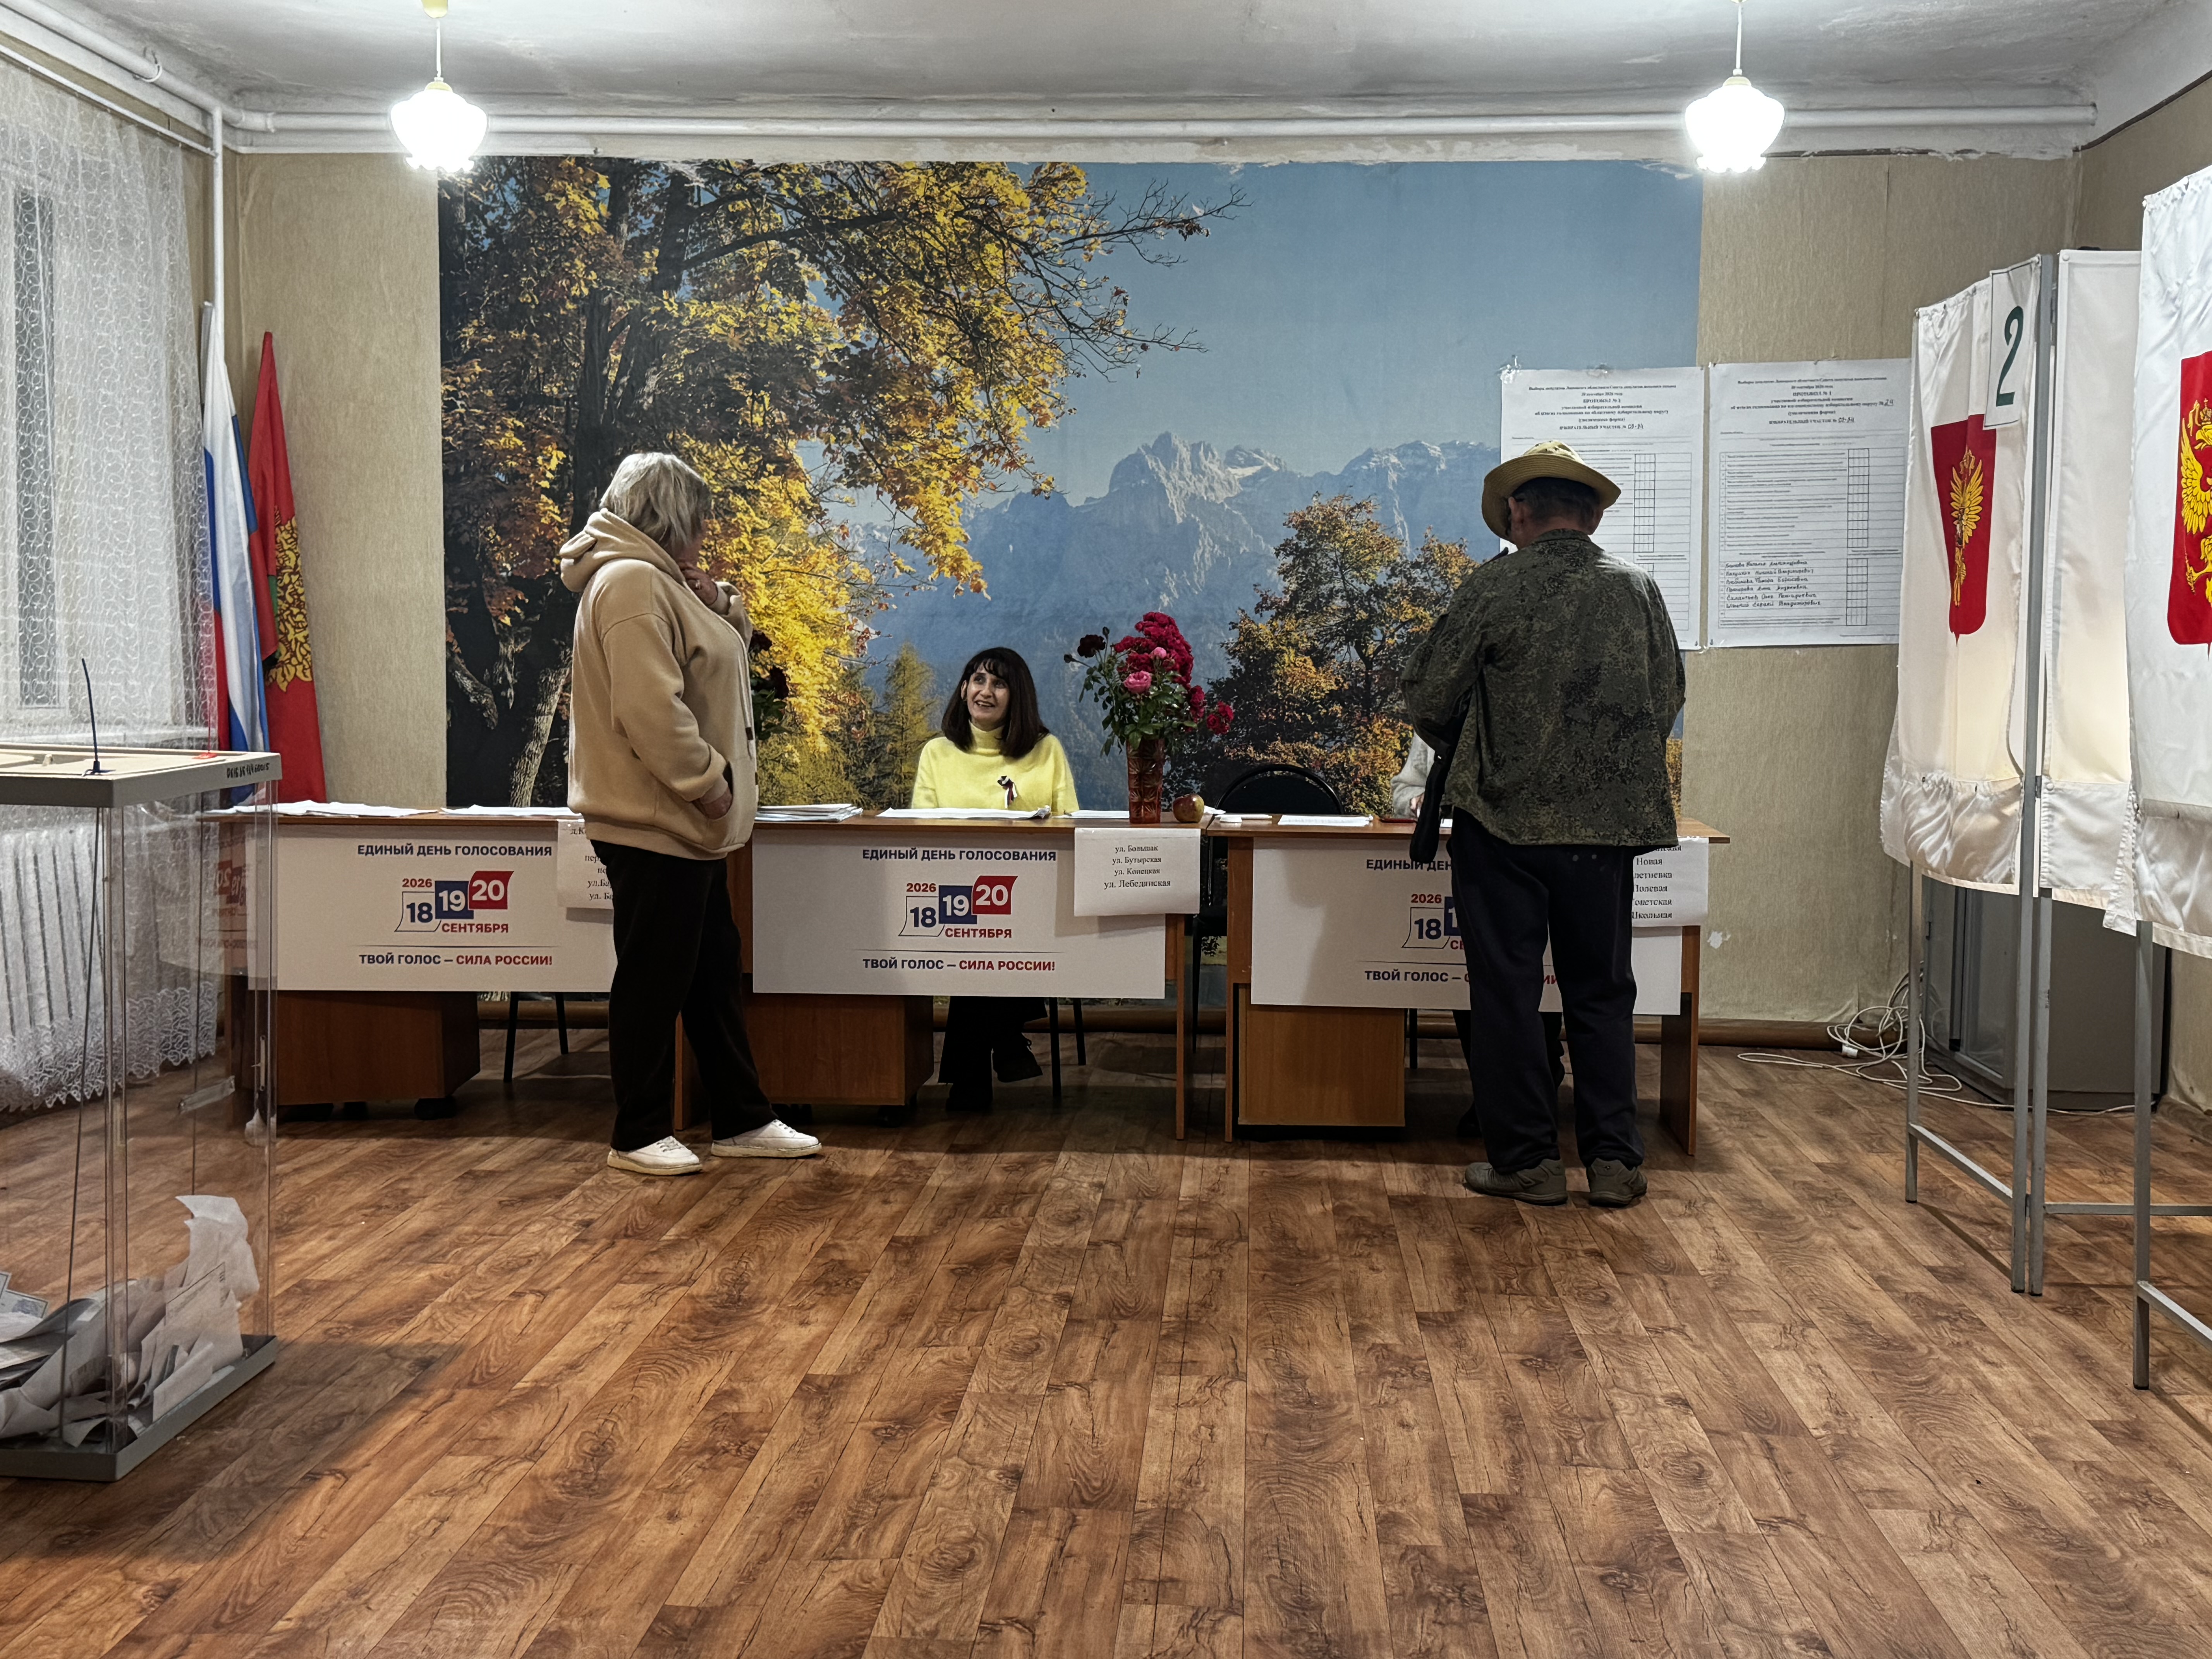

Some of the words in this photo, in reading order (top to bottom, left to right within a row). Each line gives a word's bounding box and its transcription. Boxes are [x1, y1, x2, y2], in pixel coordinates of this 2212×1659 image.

[1996, 305, 2024, 407] 2
[357, 843, 414, 856] ЕДИНЫЙ
[417, 845, 452, 857] ДЕНЬ
[455, 845, 552, 856] ГОЛОСОВАНИЯ
[862, 847, 918, 860] ЕДИНЫЙ
[921, 850, 956, 861] ДЕНЬ
[959, 850, 1056, 861] ГОЛОСОВАНИЯ
[1125, 856, 1161, 865] Бутырская
[1427, 860, 1452, 872] ДЕН
[1637, 857, 1662, 866] Новая
[402, 878, 433, 888] 2026
[906, 883, 936, 892] 2026
[1104, 881, 1116, 890] ул.
[1118, 879, 1171, 888] Лебедянская
[472, 879, 505, 901] 20
[975, 884, 1008, 906] 20
[438, 890, 466, 912] 19
[589, 893, 601, 901] ул.
[1411, 893, 1442, 904] 2026
[943, 895, 969, 916] 19
[406, 902, 433, 923] 18
[910, 907, 937, 928] 18
[1448, 907, 1458, 928] 1
[441, 923, 509, 933] СЕНТЯБРЯ
[945, 928, 1012, 938] СЕНТЯБРЯ
[1414, 918, 1442, 940] 18
[359, 952, 394, 965] ТВОЙ
[398, 954, 441, 965] ГОЛОС
[456, 955, 492, 965] СИЛА
[495, 955, 553, 965] РОССИИ!
[862, 957, 897, 969] ТВОЙ
[901, 959, 944, 970] ГОЛОС
[959, 960, 994, 970] СИЛА
[998, 960, 1055, 971] РОССИИ!
[1365, 969, 1400, 981] ТВОЙ
[1404, 970, 1449, 982] ГОЛОС
